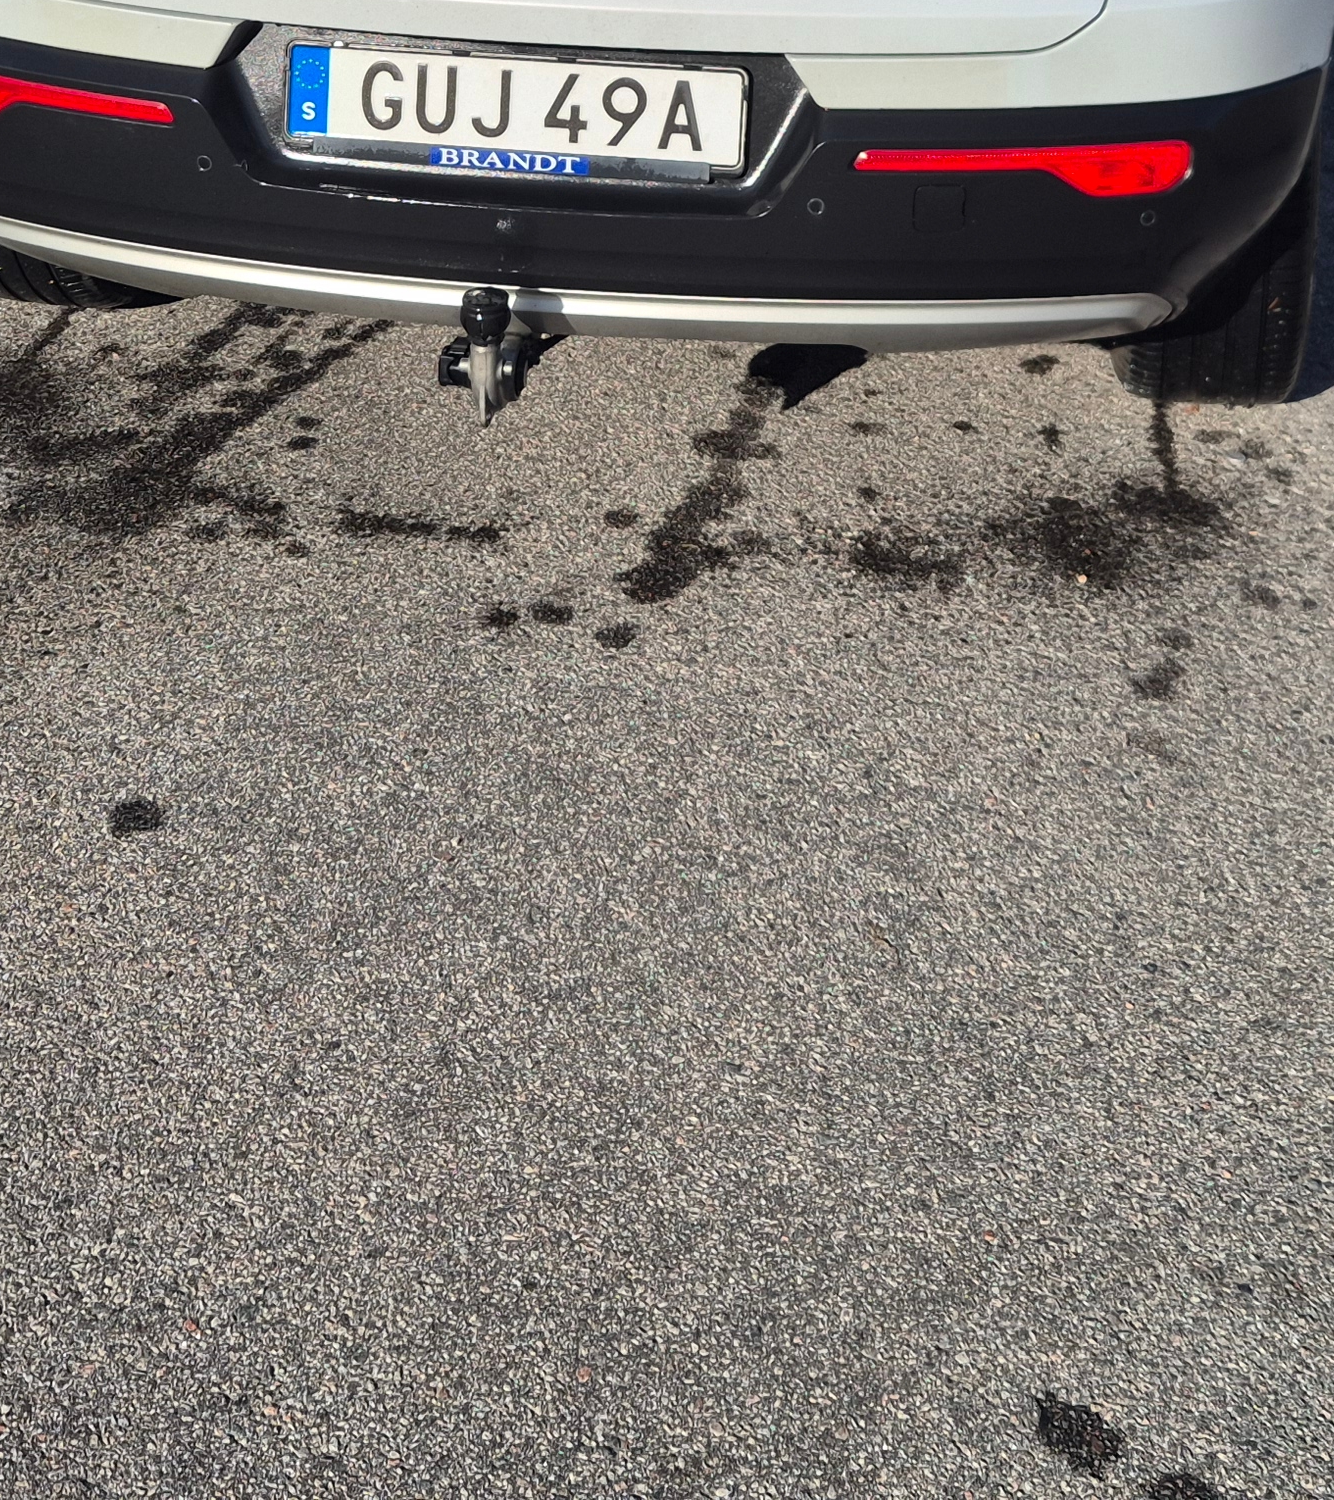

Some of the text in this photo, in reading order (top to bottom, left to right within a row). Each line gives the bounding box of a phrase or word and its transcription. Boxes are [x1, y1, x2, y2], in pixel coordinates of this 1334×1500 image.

[300, 101, 317, 121] S
[361, 60, 704, 152] GUJ 49A
[438, 147, 581, 174] BRANDT
